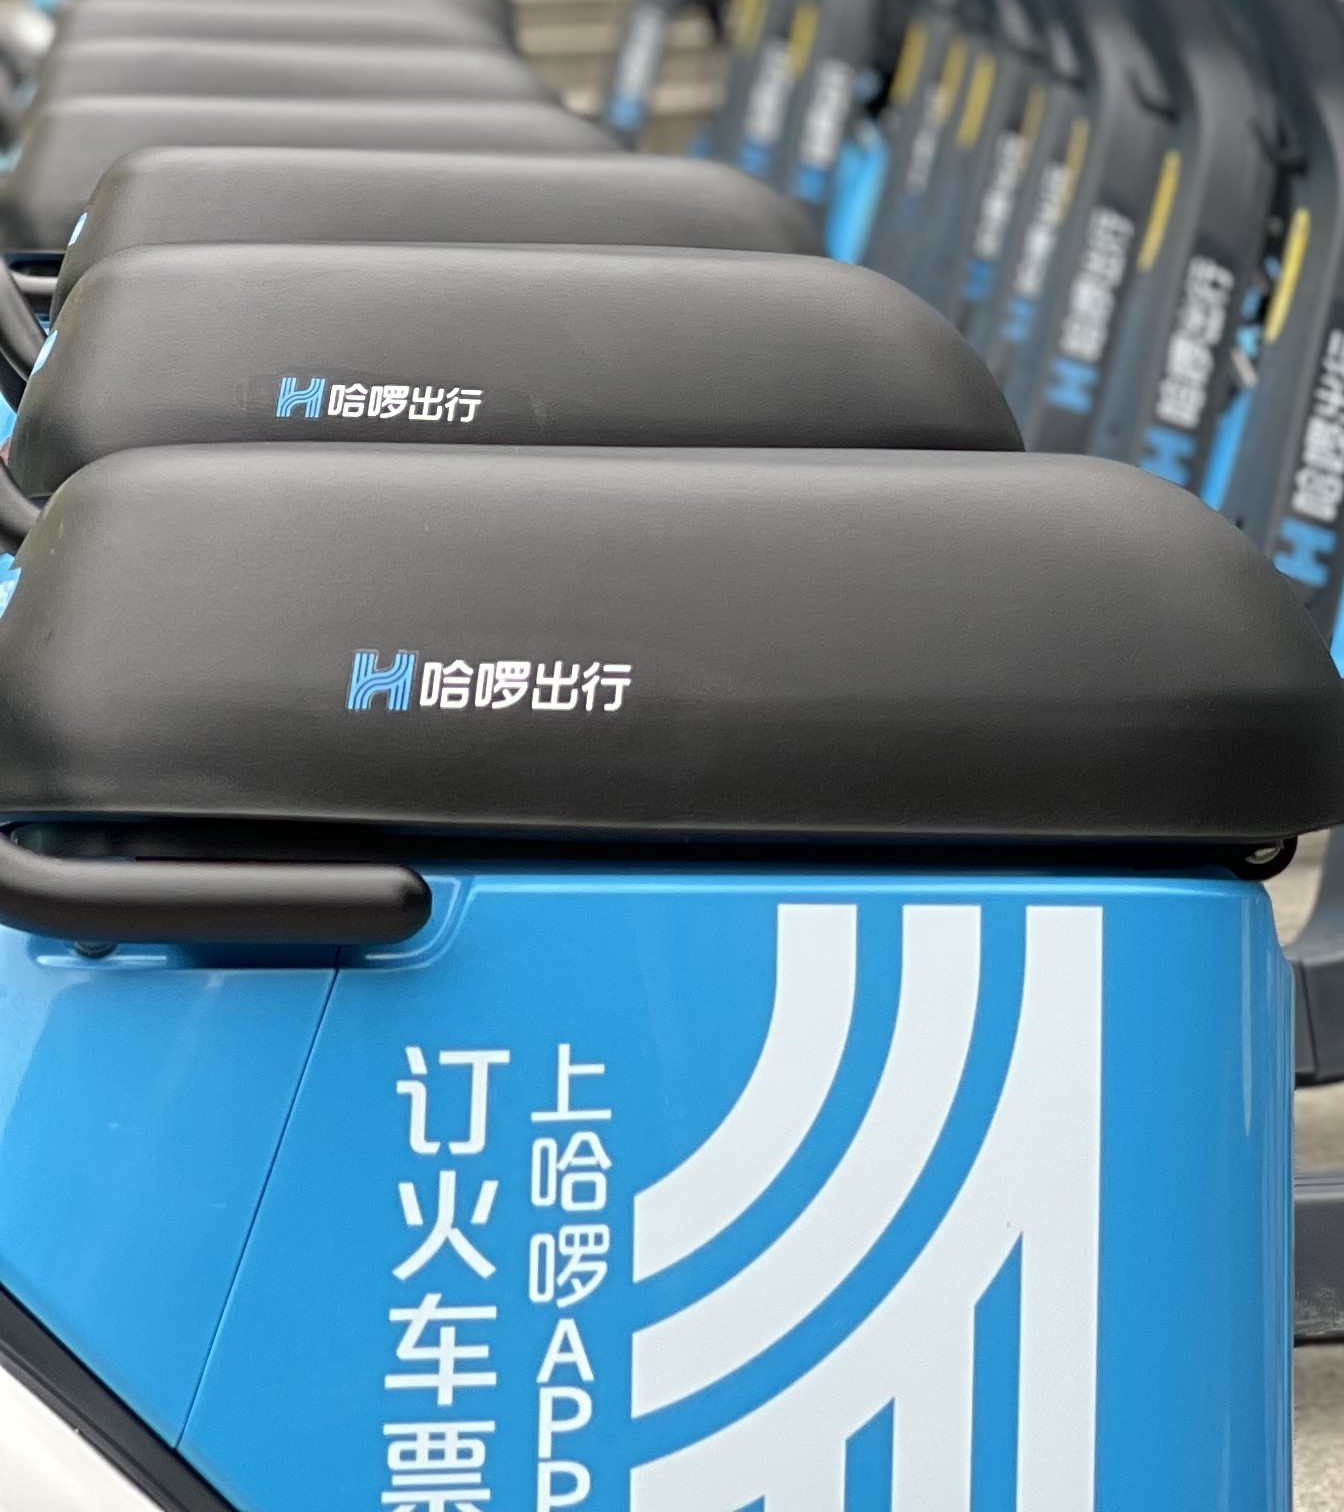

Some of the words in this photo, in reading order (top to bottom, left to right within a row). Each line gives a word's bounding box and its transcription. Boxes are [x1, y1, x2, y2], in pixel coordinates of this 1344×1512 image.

[328, 381, 483, 423] 哈啰出行
[419, 659, 632, 711] 哈啰出行
[381, 1046, 510, 1512] 订火车票
